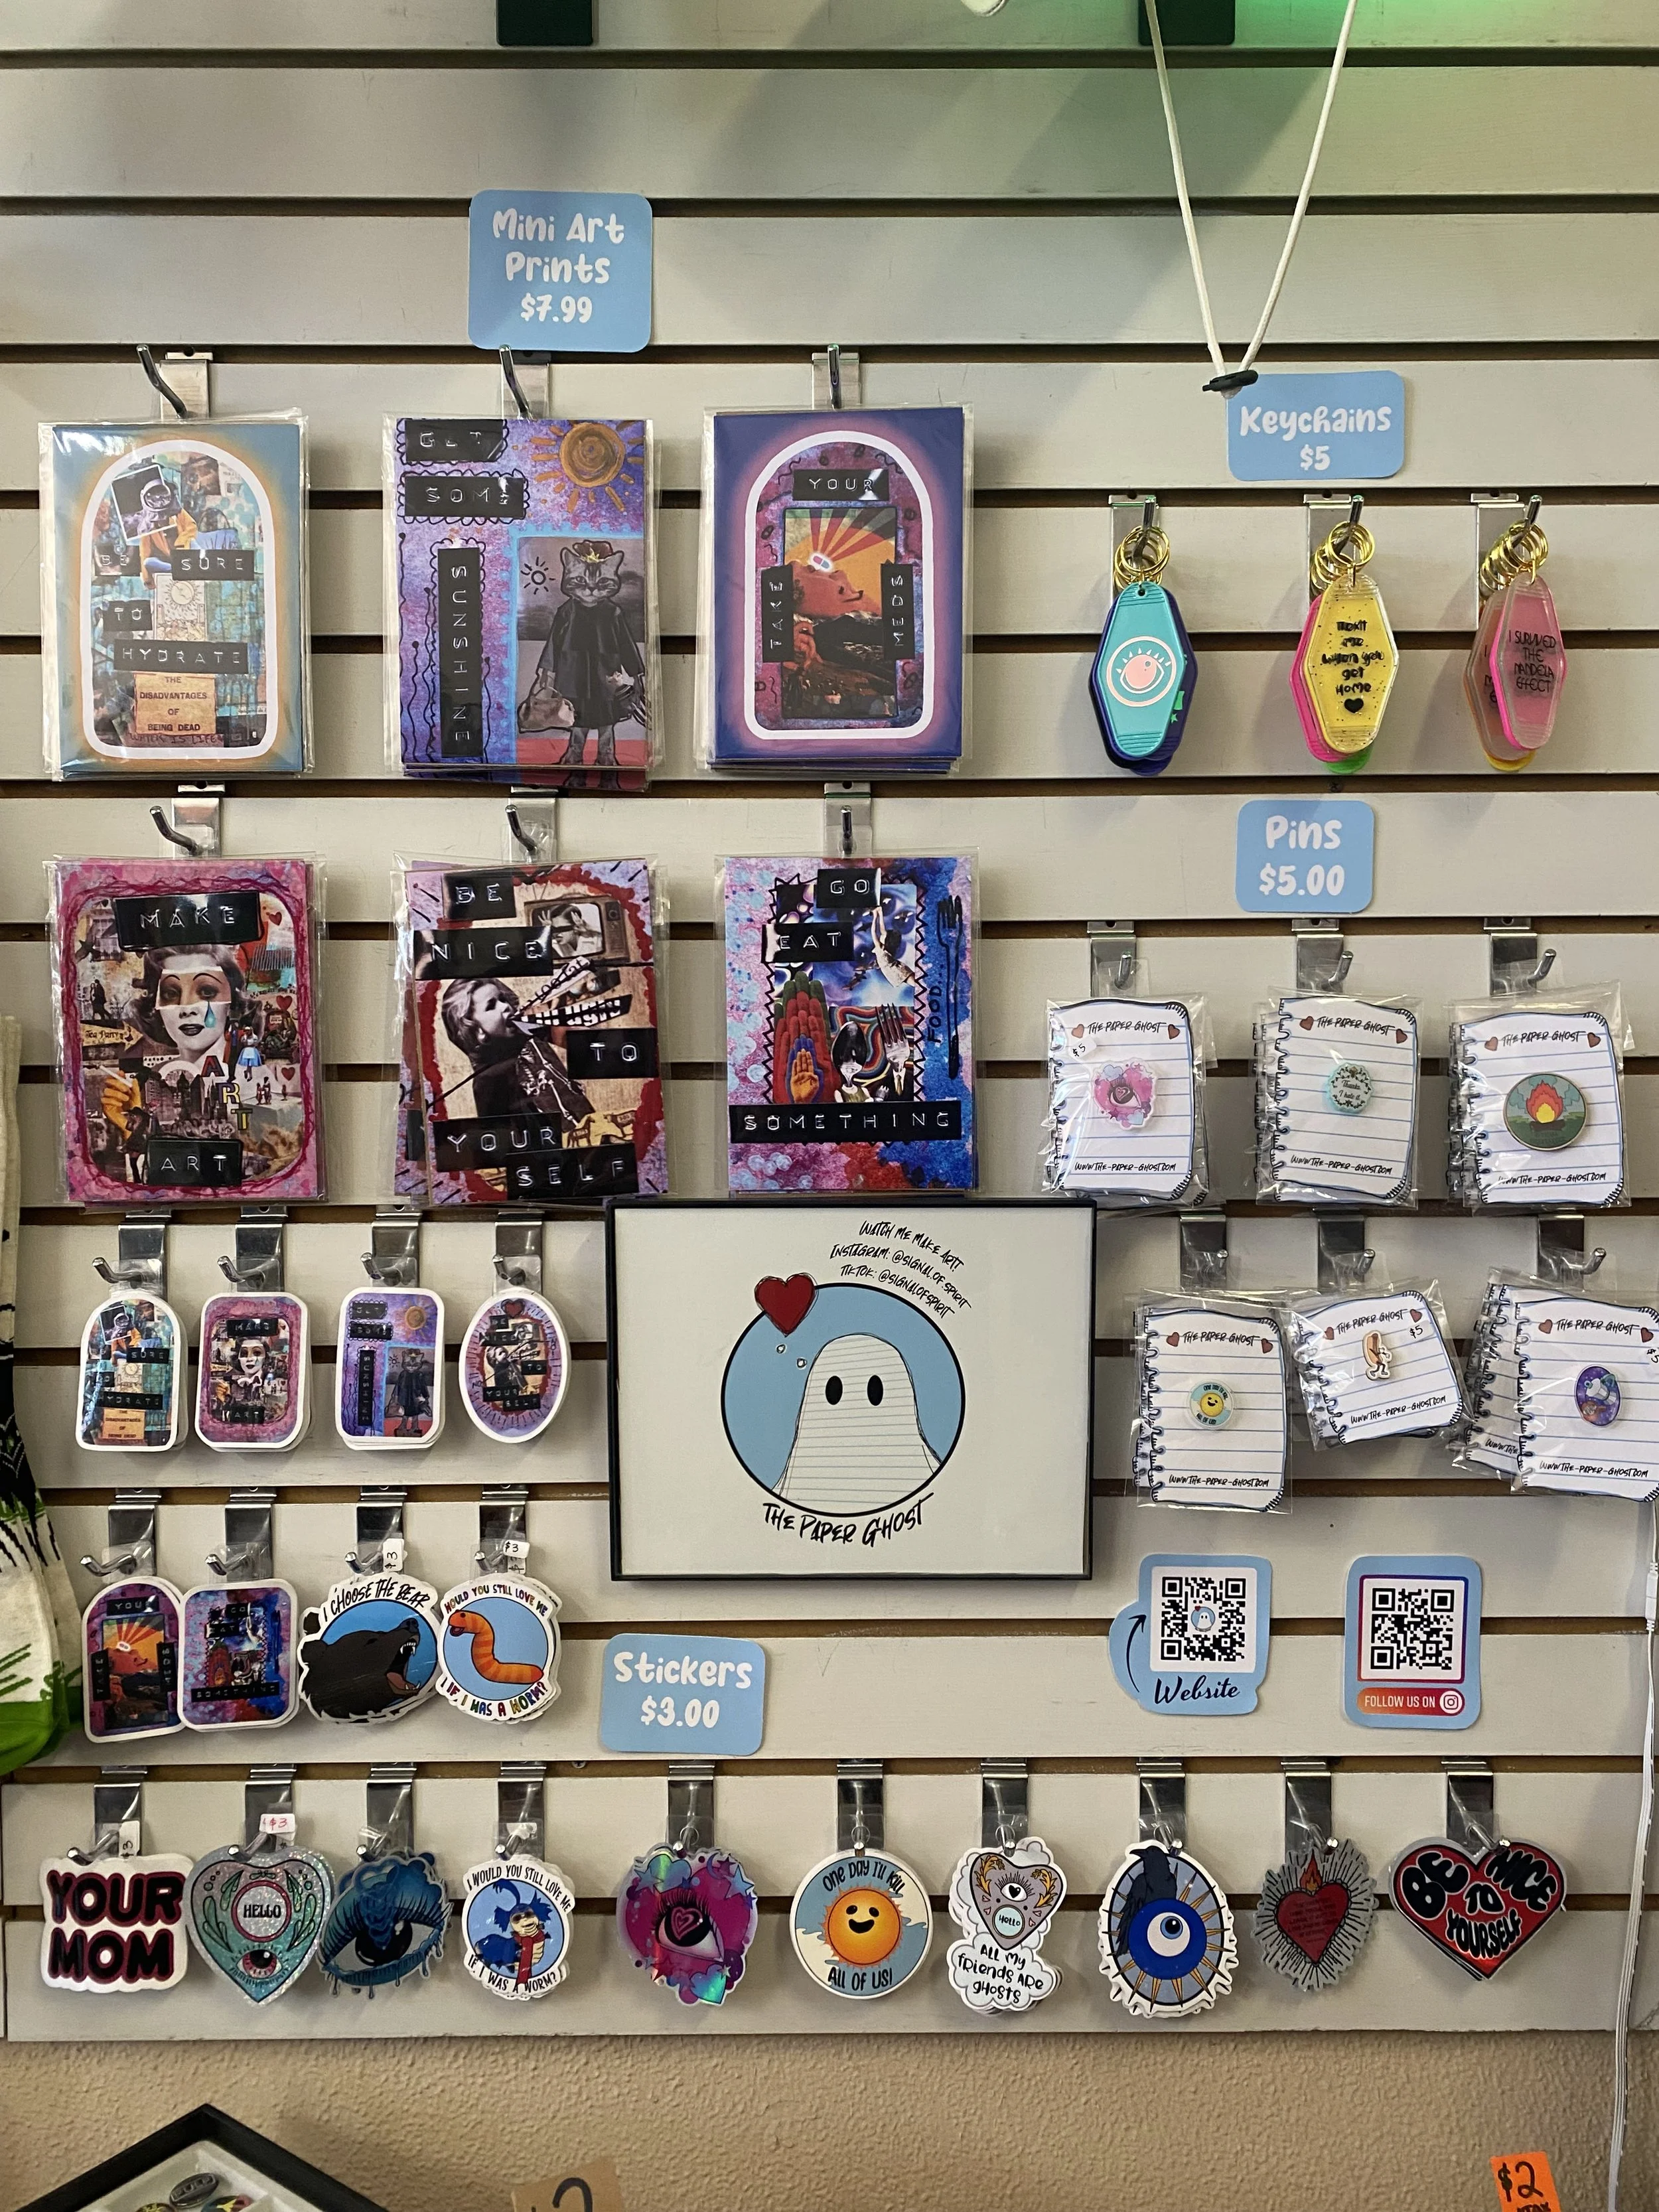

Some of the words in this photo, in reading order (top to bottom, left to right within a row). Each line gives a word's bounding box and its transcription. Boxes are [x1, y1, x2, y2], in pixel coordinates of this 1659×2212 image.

[493, 208, 555, 242] Mini
[566, 213, 624, 244] Art
[505, 251, 611, 284] Prints
[520, 293, 593, 323] $7.99
[1240, 406, 1392, 441] Keychains
[1300, 444, 1331, 471] $5
[808, 477, 874, 491] YOUR
[102, 553, 129, 567] BE
[180, 557, 244, 571] SURE
[114, 607, 143, 621] TO
[769, 581, 783, 650] TAKE
[891, 575, 904, 647] MEDS
[1515, 630, 1556, 648] SURVIVED
[122, 646, 241, 665] HYDRATE
[451, 565, 470, 741] SUNSHINE
[1523, 647, 1544, 662] THE
[1514, 662, 1554, 679] MANDELA
[1516, 677, 1551, 693] EFFECT
[1265, 815, 1342, 849] Pins
[830, 879, 869, 896] GO
[1259, 863, 1345, 896] $5.00
[455, 885, 502, 905] BE
[139, 906, 237, 929] MAKE
[431, 940, 543, 961] NICE
[778, 932, 841, 950] EAT
[1088, 1022, 1104, 1034] THE
[1105, 1021, 1131, 1031] PAPER
[1134, 1022, 1167, 1033] GHOST
[1317, 1016, 1333, 1028] THE
[1334, 1017, 1362, 1029] PAPER
[1363, 1021, 1396, 1036] GHOST
[1502, 1033, 1519, 1047] THE
[1520, 1031, 1549, 1043] PAPER
[1551, 1030, 1586, 1042] GHOST
[590, 1041, 640, 1062] TO
[1072, 1043, 1086, 1057] $5
[744, 1111, 950, 1131] SOMETHING
[447, 1126, 556, 1153] YOUR
[160, 1154, 227, 1172] ART
[516, 1160, 624, 1188] SELF
[859, 1220, 895, 1239] WATCH
[895, 1226, 912, 1240] ME
[912, 1233, 941, 1254] MAKE
[1336, 1321, 1352, 1335] THE
[1352, 1315, 1376, 1328] PAPER
[1379, 1309, 1407, 1322] GHOST
[1409, 1325, 1423, 1339] $5
[1556, 1319, 1573, 1331] THE
[1575, 1319, 1603, 1330] PAPER
[1605, 1323, 1639, 1335] GHOST
[1183, 1331, 1199, 1343] THE
[1200, 1331, 1228, 1342] PAPER
[1228, 1334, 1260, 1346] GHOST
[762, 1503, 795, 1531] THE
[799, 1514, 857, 1544] PAPER
[862, 1492, 934, 1548] GHOST
[505, 1542, 519, 1552] $3
[323, 1607, 328, 1622] I
[330, 1582, 374, 1616] CHOOSE
[373, 1577, 399, 1599] THE
[395, 1584, 430, 1609] BEAR
[444, 1591, 469, 1614] WOULD
[472, 1585, 490, 1597] YOU
[493, 1584, 512, 1595] STILL
[515, 1587, 535, 1606] LOVE
[536, 1601, 548, 1617] ME
[613, 1651, 753, 1689] Stickers
[447, 1682, 461, 1696] IF
[461, 1694, 468, 1706] I
[470, 1699, 492, 1716] WAS
[498, 1702, 506, 1717] A
[509, 1681, 548, 1714] WORM?
[1154, 1674, 1240, 1704] Website
[1364, 1695, 1404, 1708] FOLLOW
[1406, 1696, 1419, 1708] US
[1422, 1696, 1435, 1708] ON
[640, 1695, 720, 1728] $3.00
[269, 1817, 287, 1832] $3
[46, 1869, 186, 1927] YOUR
[472, 1866, 502, 1887] WOULD
[506, 1864, 522, 1878] YOU
[525, 1867, 543, 1886] STILL
[545, 1879, 562, 1901] LOVE
[560, 1895, 571, 1911] ME
[1400, 1850, 1471, 1921] BE
[1484, 1849, 1557, 1913] NICE
[1463, 1881, 1505, 1915] TO
[243, 1905, 281, 1918] HELLO
[1445, 1907, 1522, 1960] YOURSELF
[48, 1927, 175, 1984] MOM
[479, 1966, 485, 1978] I
[488, 1972, 509, 1991] WAS
[525, 1972, 557, 1993] WORM?
[1498, 2161, 1544, 2202] $2
